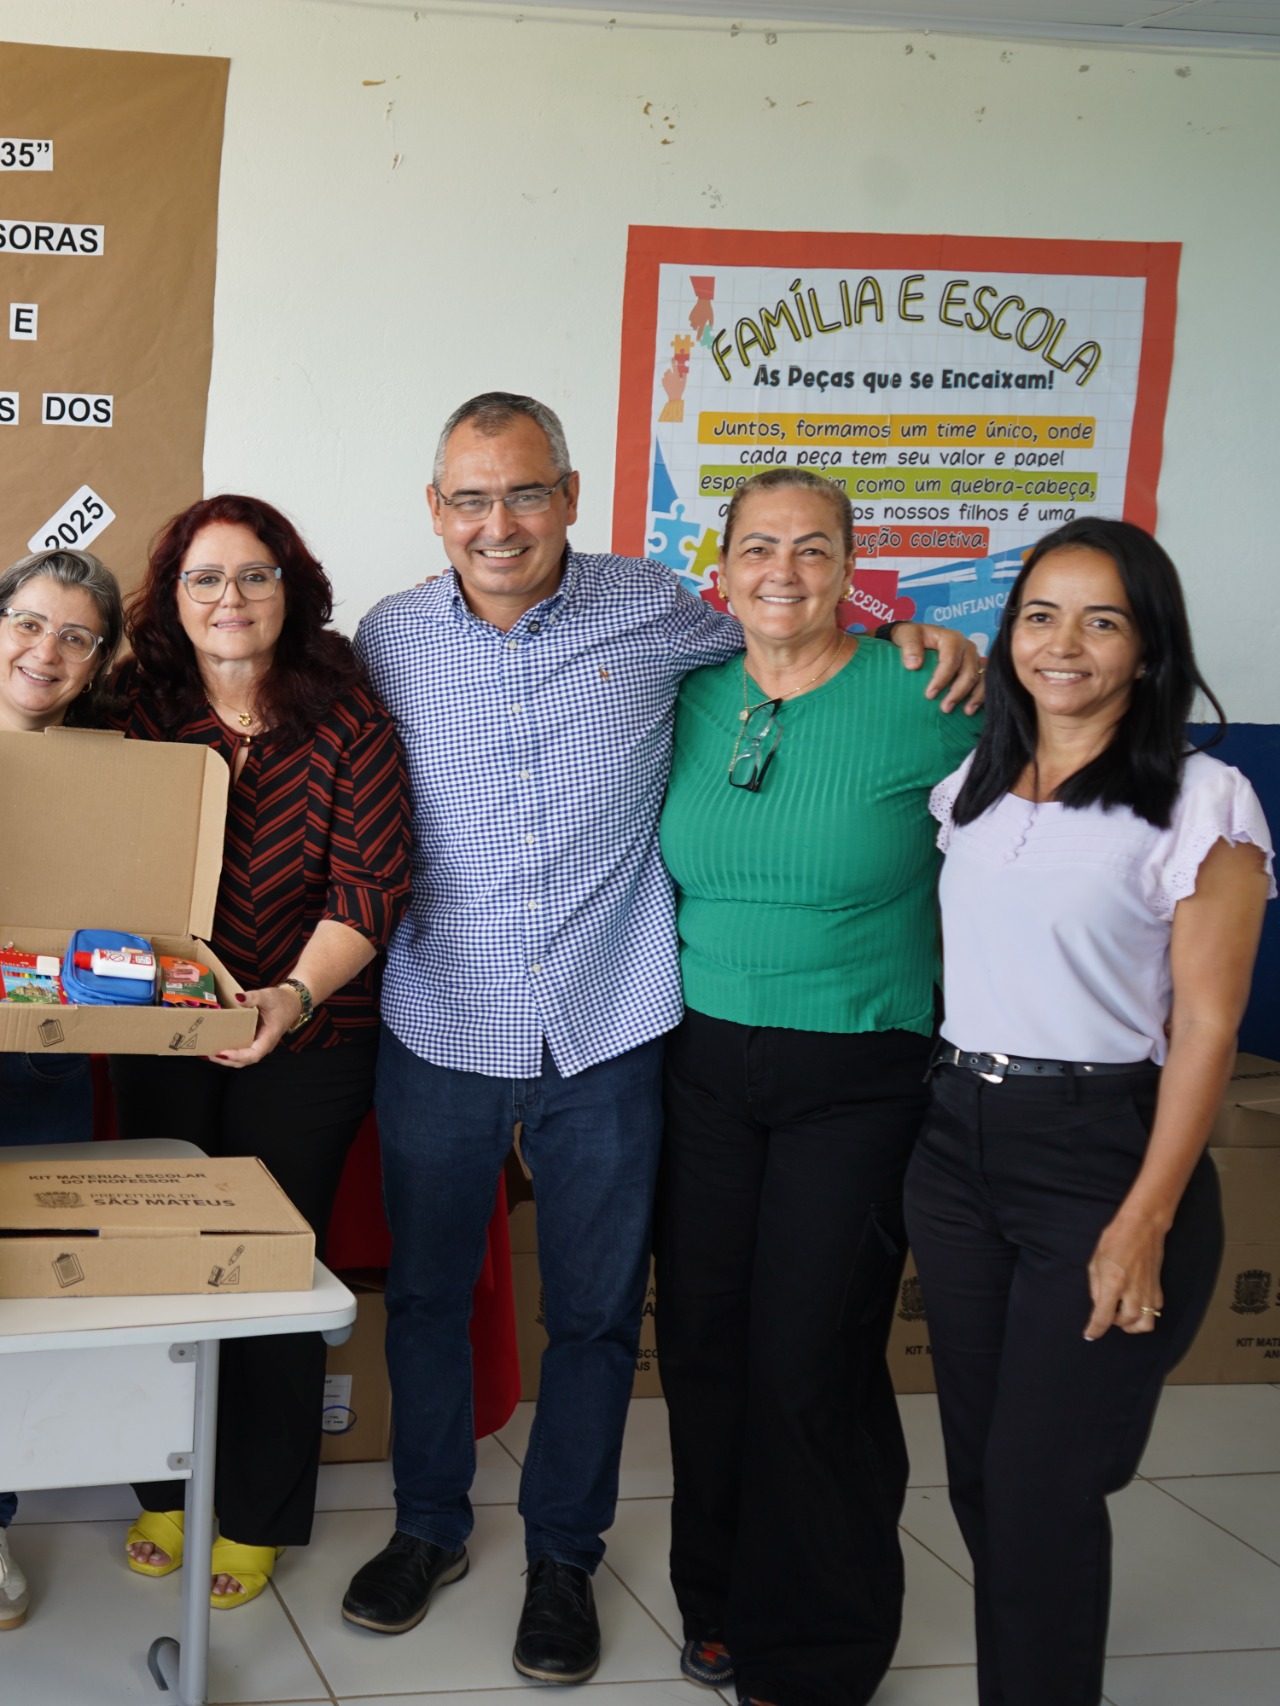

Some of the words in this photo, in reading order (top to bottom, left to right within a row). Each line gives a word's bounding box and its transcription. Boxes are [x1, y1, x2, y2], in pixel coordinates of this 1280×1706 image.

[14, 308, 33, 334] E
[711, 276, 885, 382] FAMÍLIA
[898, 274, 927, 323] E
[938, 279, 1102, 387] ESCOLA
[753, 364, 781, 387] As
[788, 365, 856, 393] Peças
[863, 371, 902, 393] que
[910, 371, 934, 389] se
[941, 369, 1055, 390] Encaixam!
[45, 396, 111, 423] DOS
[714, 419, 787, 440] Juntos,
[796, 420, 891, 439] formamos
[901, 424, 927, 438] um
[937, 423, 977, 438] time
[986, 421, 1038, 442] único,
[1048, 423, 1093, 440] onde
[740, 447, 787, 465] cada
[797, 450, 842, 471] peça
[852, 450, 887, 465] tem
[897, 452, 930, 466] seu
[939, 450, 985, 466] valor
[994, 451, 1006, 466] e
[1011, 450, 1065, 469] papel
[701, 475, 747, 492] espe
[856, 479, 905, 493] como
[915, 479, 941, 493] um
[951, 478, 1096, 502] quebra-cabeça,
[44, 495, 104, 550] 2025
[852, 506, 874, 520] os
[884, 506, 950, 520] nossos
[959, 503, 1009, 521] filhos
[1017, 503, 1029, 521] é
[1038, 508, 1076, 522] uma
[910, 530, 988, 548] coletiva.
[848, 586, 896, 624] CERIA
[93, 1198, 140, 1206] SÃO
[145, 1199, 236, 1207] MATEUS
[905, 1345, 924, 1356] KIT
[1236, 1337, 1254, 1348] KIT
